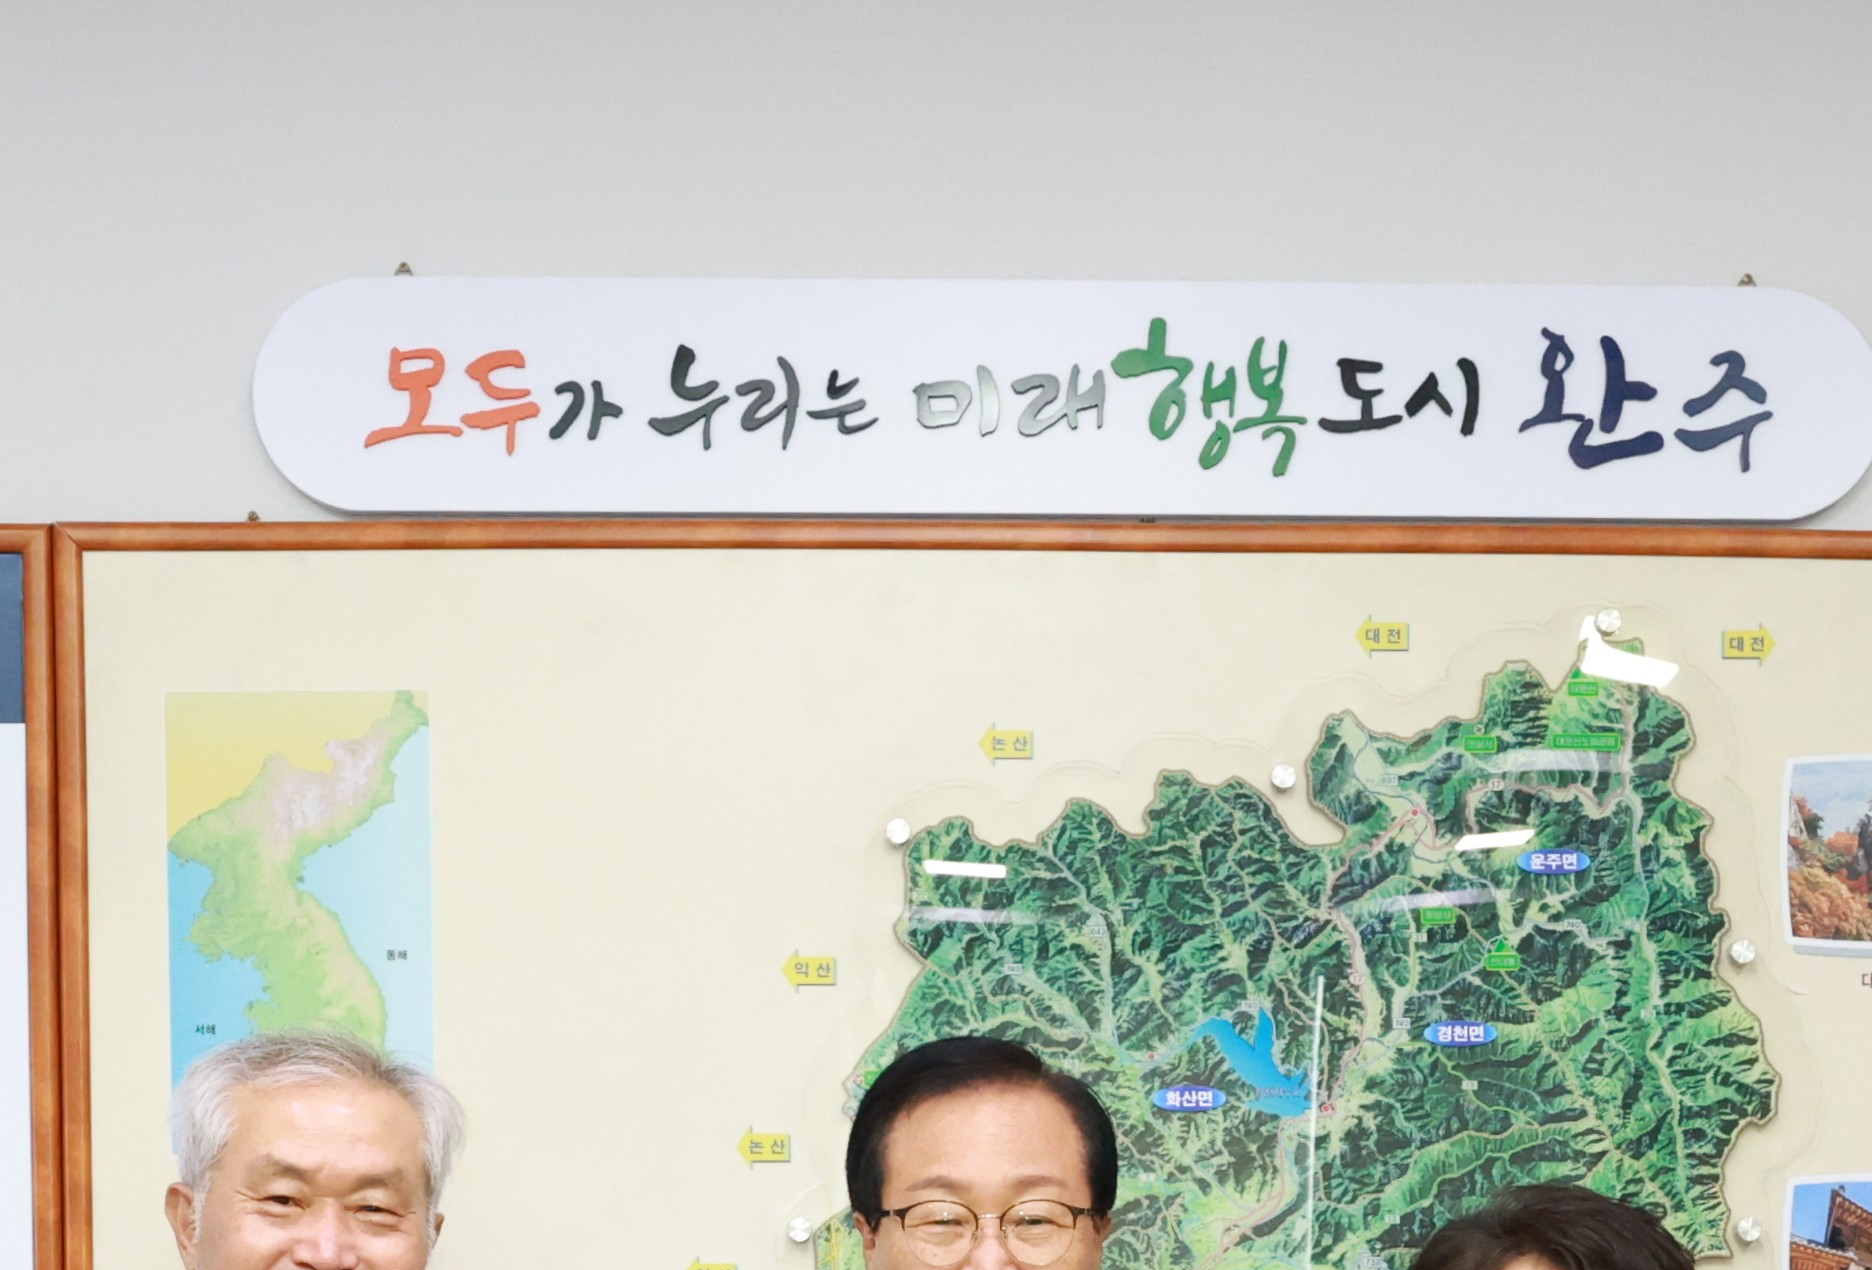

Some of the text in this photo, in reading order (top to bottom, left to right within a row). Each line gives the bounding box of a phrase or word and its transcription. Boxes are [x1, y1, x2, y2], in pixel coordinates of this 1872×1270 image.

[363, 346, 623, 454] 모두가
[647, 343, 879, 452] 누리는
[1518, 326, 1774, 474] 완주
[1365, 627, 1401, 645] 대전
[1729, 636, 1765, 653] 대전
[989, 733, 1030, 754] 논산
[1529, 852, 1578, 871] 운주면
[386, 949, 408, 961] 동해
[794, 961, 832, 980] 익산
[194, 1024, 216, 1036] 서해
[1436, 1023, 1486, 1043] 경천면
[1164, 1087, 1215, 1108] 화산면
[748, 1138, 787, 1157] 논산
